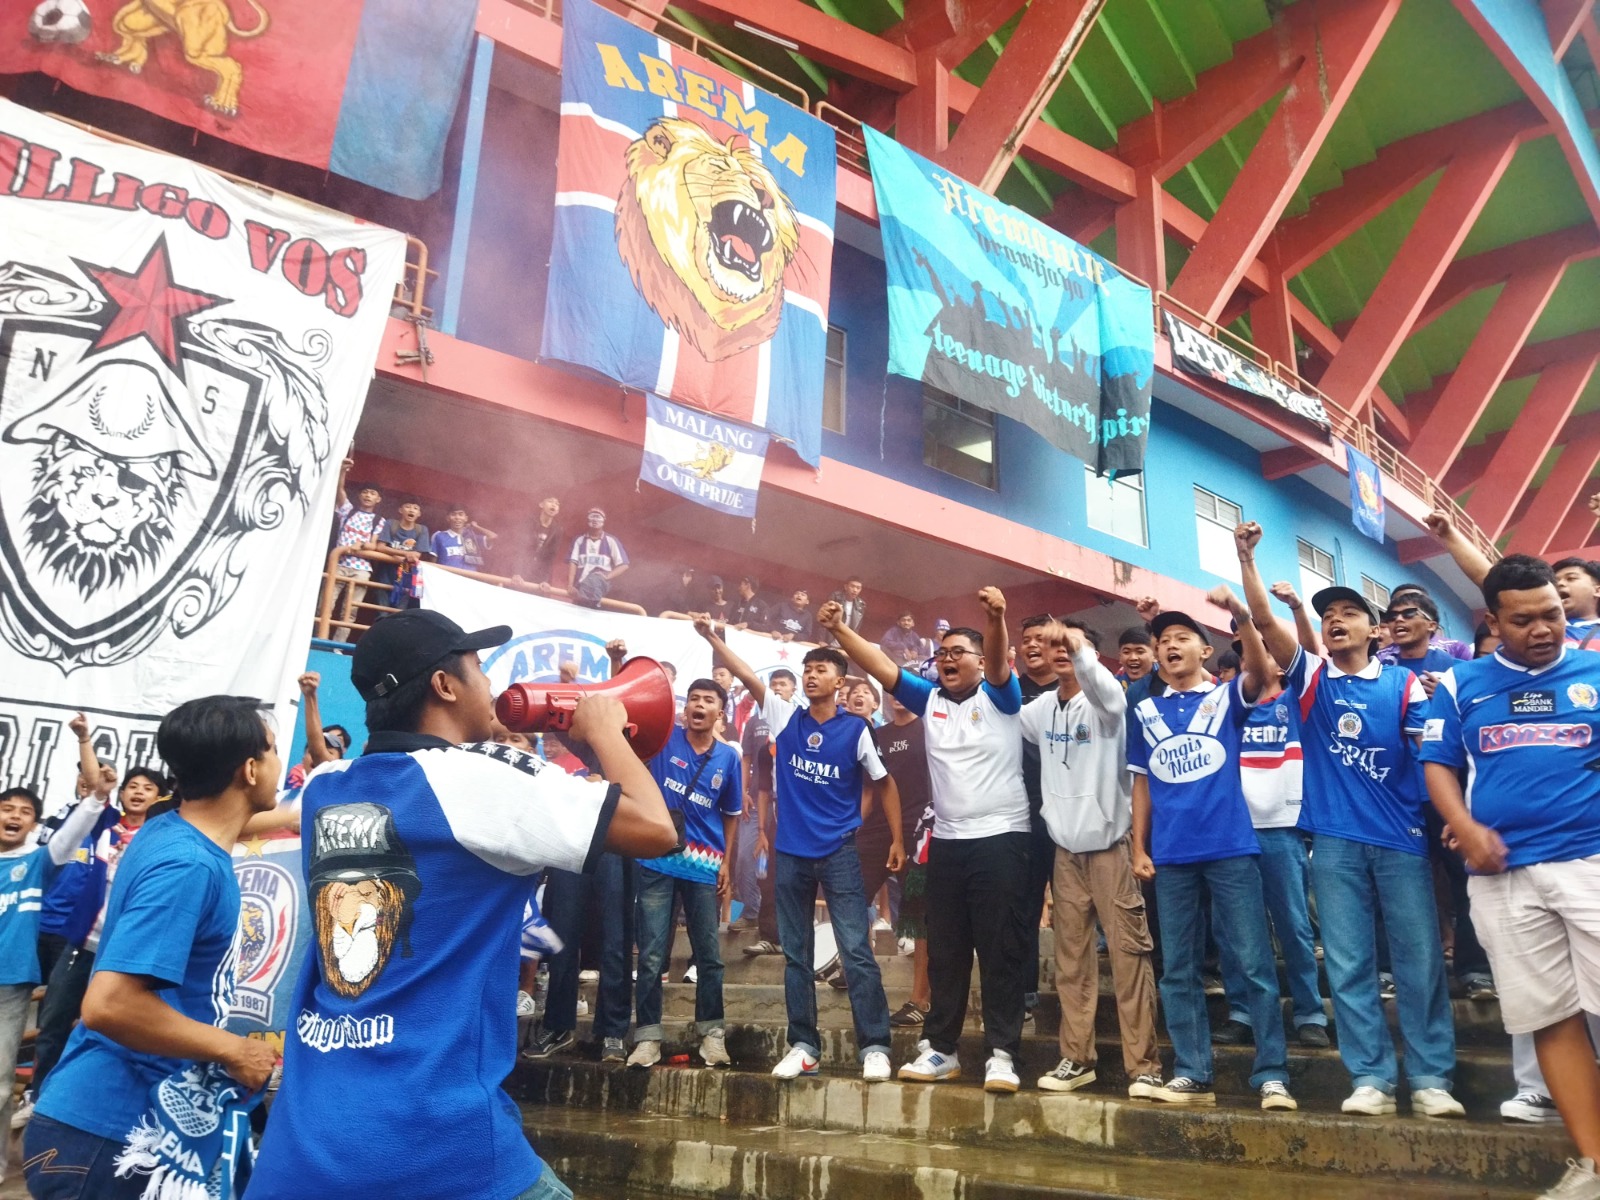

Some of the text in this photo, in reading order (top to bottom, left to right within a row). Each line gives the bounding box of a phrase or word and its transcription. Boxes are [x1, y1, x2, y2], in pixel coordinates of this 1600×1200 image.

[594, 41, 809, 178] AREMA
[243, 219, 367, 319] VOS
[29, 346, 58, 382] N
[932, 320, 1028, 398] teenage
[201, 384, 222, 415] S
[664, 406, 753, 450] MALANG
[656, 463, 744, 510] OUR PRIDE
[1513, 705, 1553, 713] MANDIRI
[788, 753, 841, 779] AREMA
[1156, 737, 1204, 766] Ongis
[1167, 753, 1212, 779] Nade
[314, 813, 391, 853] AREMA
[241, 994, 264, 1013] 1987
